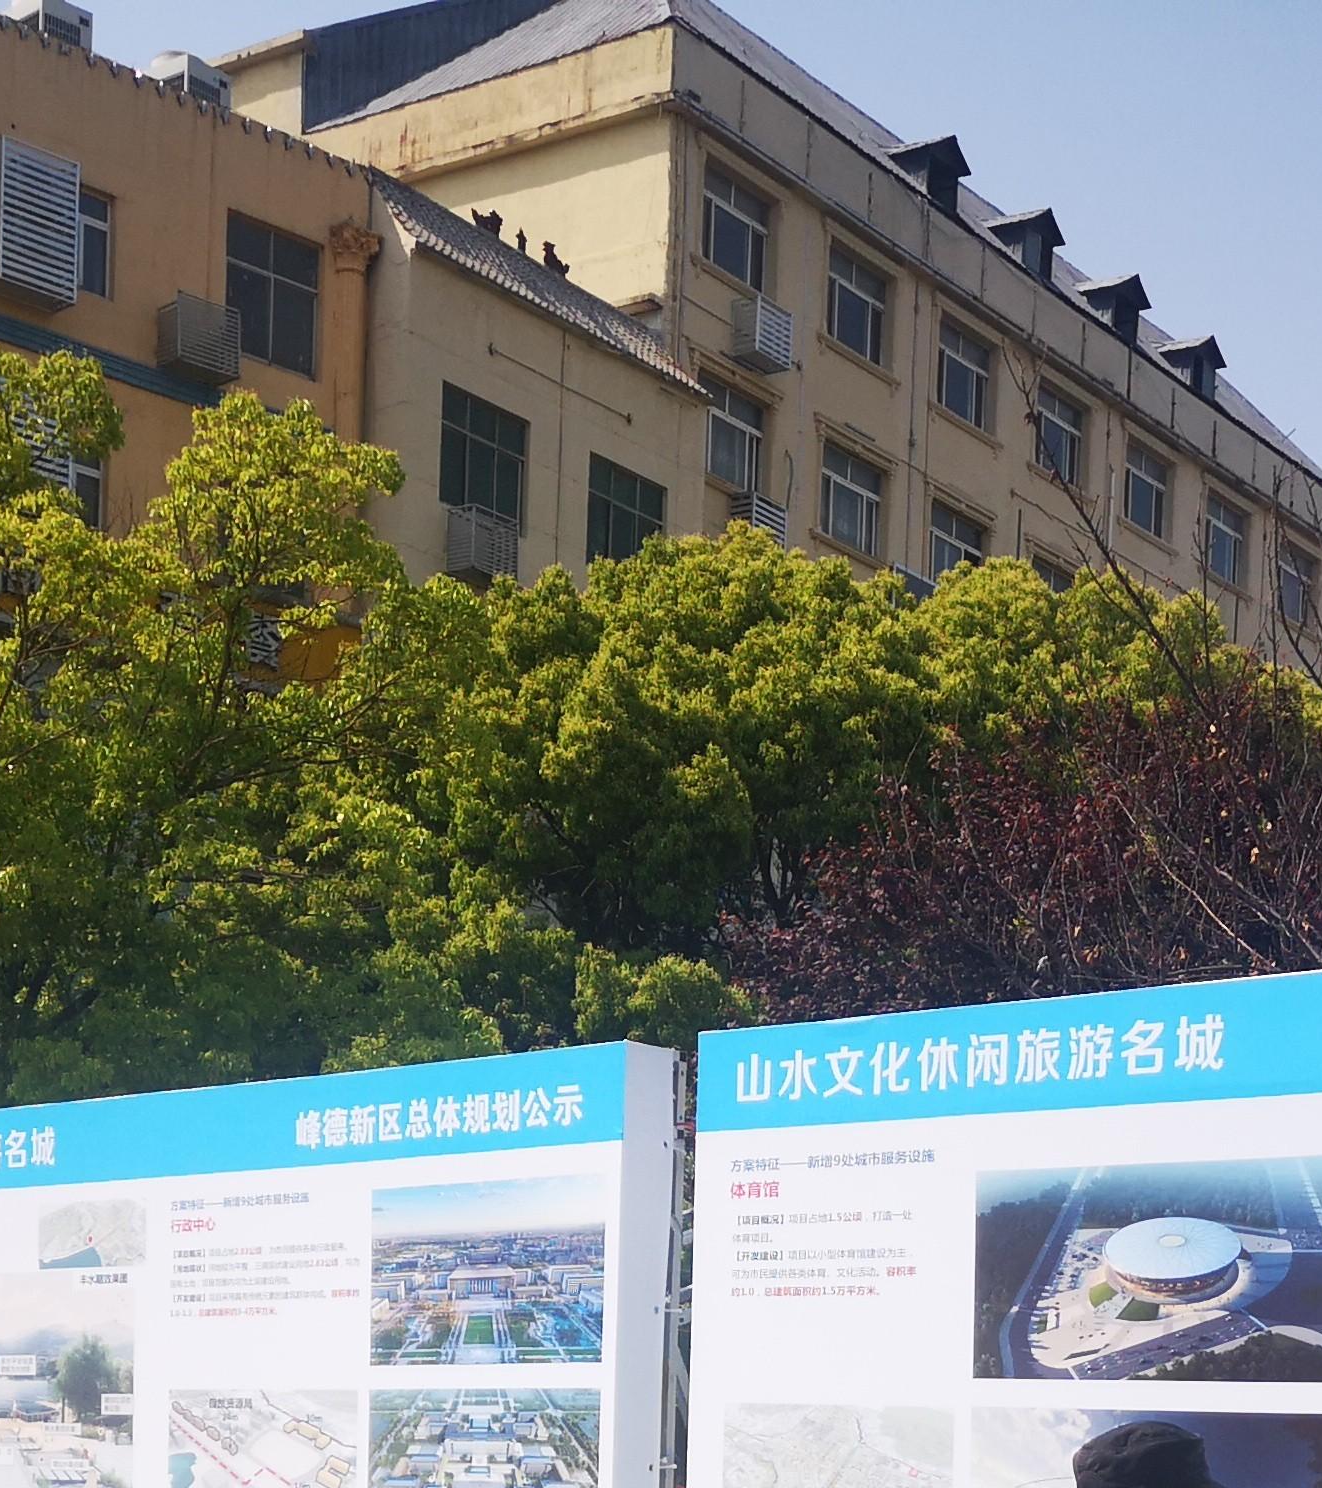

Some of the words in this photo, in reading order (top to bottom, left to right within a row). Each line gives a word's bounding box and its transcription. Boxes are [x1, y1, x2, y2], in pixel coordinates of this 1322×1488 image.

[735, 1013, 1226, 1104] 山水文化休闲旅游名城
[294, 1084, 584, 1151] 峰德新区总体规划公示
[730, 1148, 936, 1173] 方案特征——新增9处城市服务设施
[730, 1180, 780, 1199] 体育馆
[171, 1217, 216, 1234] 行政中心
